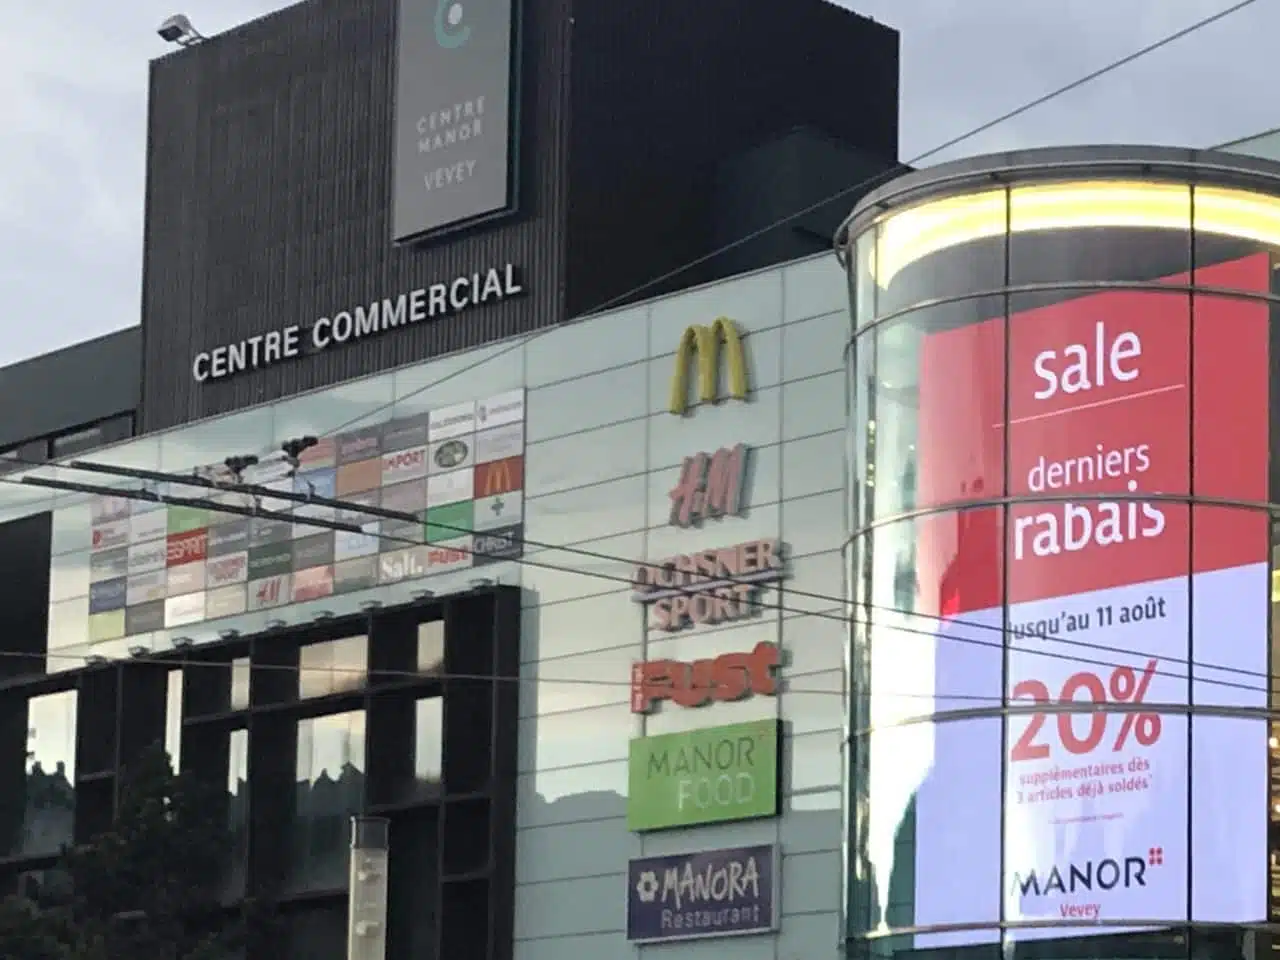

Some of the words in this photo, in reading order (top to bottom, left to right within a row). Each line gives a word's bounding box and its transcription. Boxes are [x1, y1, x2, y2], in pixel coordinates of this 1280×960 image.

[416, 96, 485, 133] CENTRE
[419, 118, 482, 153] MANOR
[424, 160, 476, 190] VEVEY
[193, 325, 299, 381] CENTRE
[312, 263, 522, 349] COMMERCIAL
[1034, 321, 1142, 400] sale
[1028, 444, 1150, 492] derniers
[1014, 480, 1165, 560] rabais
[167, 534, 207, 560] ESPRIT
[633, 538, 781, 591] OCHSNER
[653, 584, 752, 631] SPORT
[1097, 605, 1113, 627] 11
[1119, 596, 1166, 624] août
[1011, 658, 1162, 762] 20%
[648, 736, 754, 779] MANOR
[1019, 763, 1124, 786] supplémentaires
[1127, 757, 1150, 773] dès
[678, 772, 757, 813] FOOD
[1028, 785, 1073, 803] articles
[1077, 780, 1104, 799] déjà
[661, 856, 760, 910] MANORA
[1011, 856, 1147, 897] MANOR
[661, 903, 760, 929] Restaurant
[1060, 902, 1101, 921] Vevey
